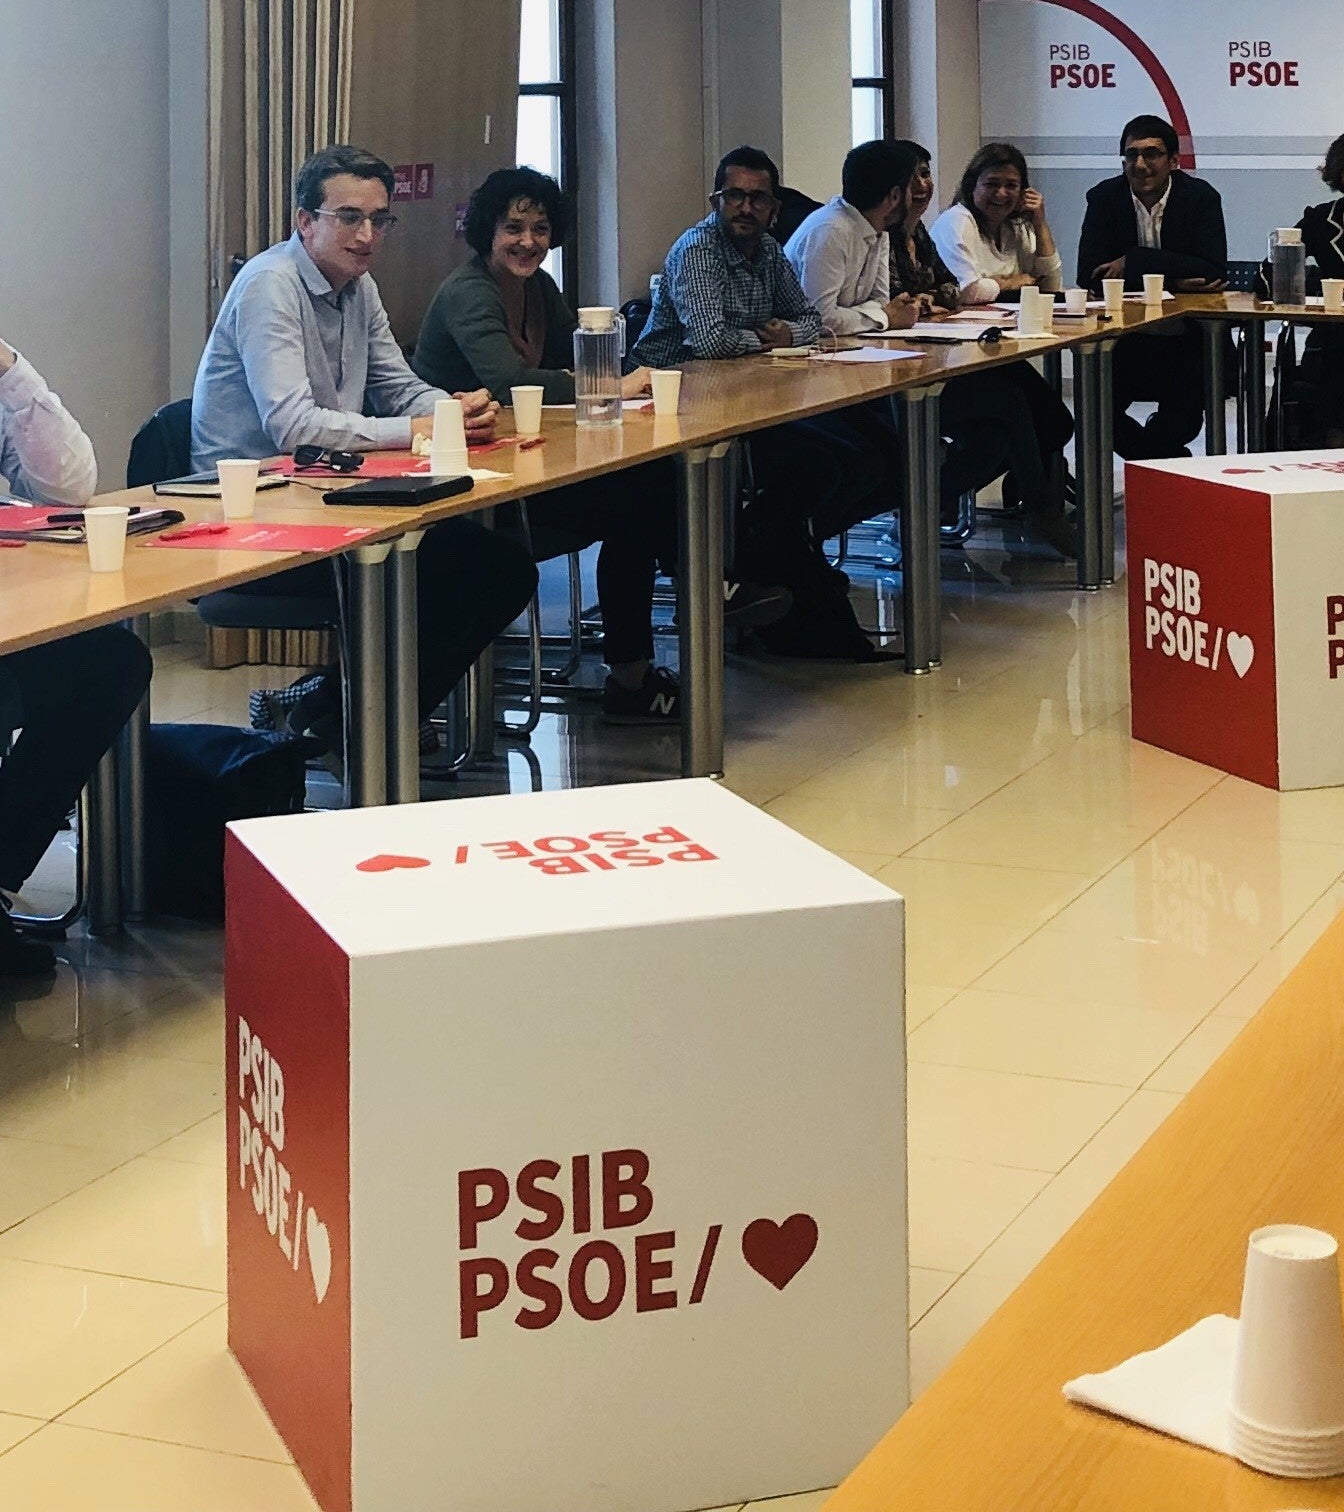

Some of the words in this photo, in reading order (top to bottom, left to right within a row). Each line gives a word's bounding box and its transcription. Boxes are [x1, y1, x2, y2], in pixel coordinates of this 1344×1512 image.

[1049, 44, 1090, 61] PSIB
[1228, 40, 1272, 58] PSIB
[1050, 63, 1116, 88] PSOE
[1229, 61, 1299, 87] PSOE
[1144, 558, 1201, 616] PSIB
[528, 842, 721, 875] PSIB
[238, 1015, 285, 1151] PSIB
[457, 1148, 654, 1251] PSIB
